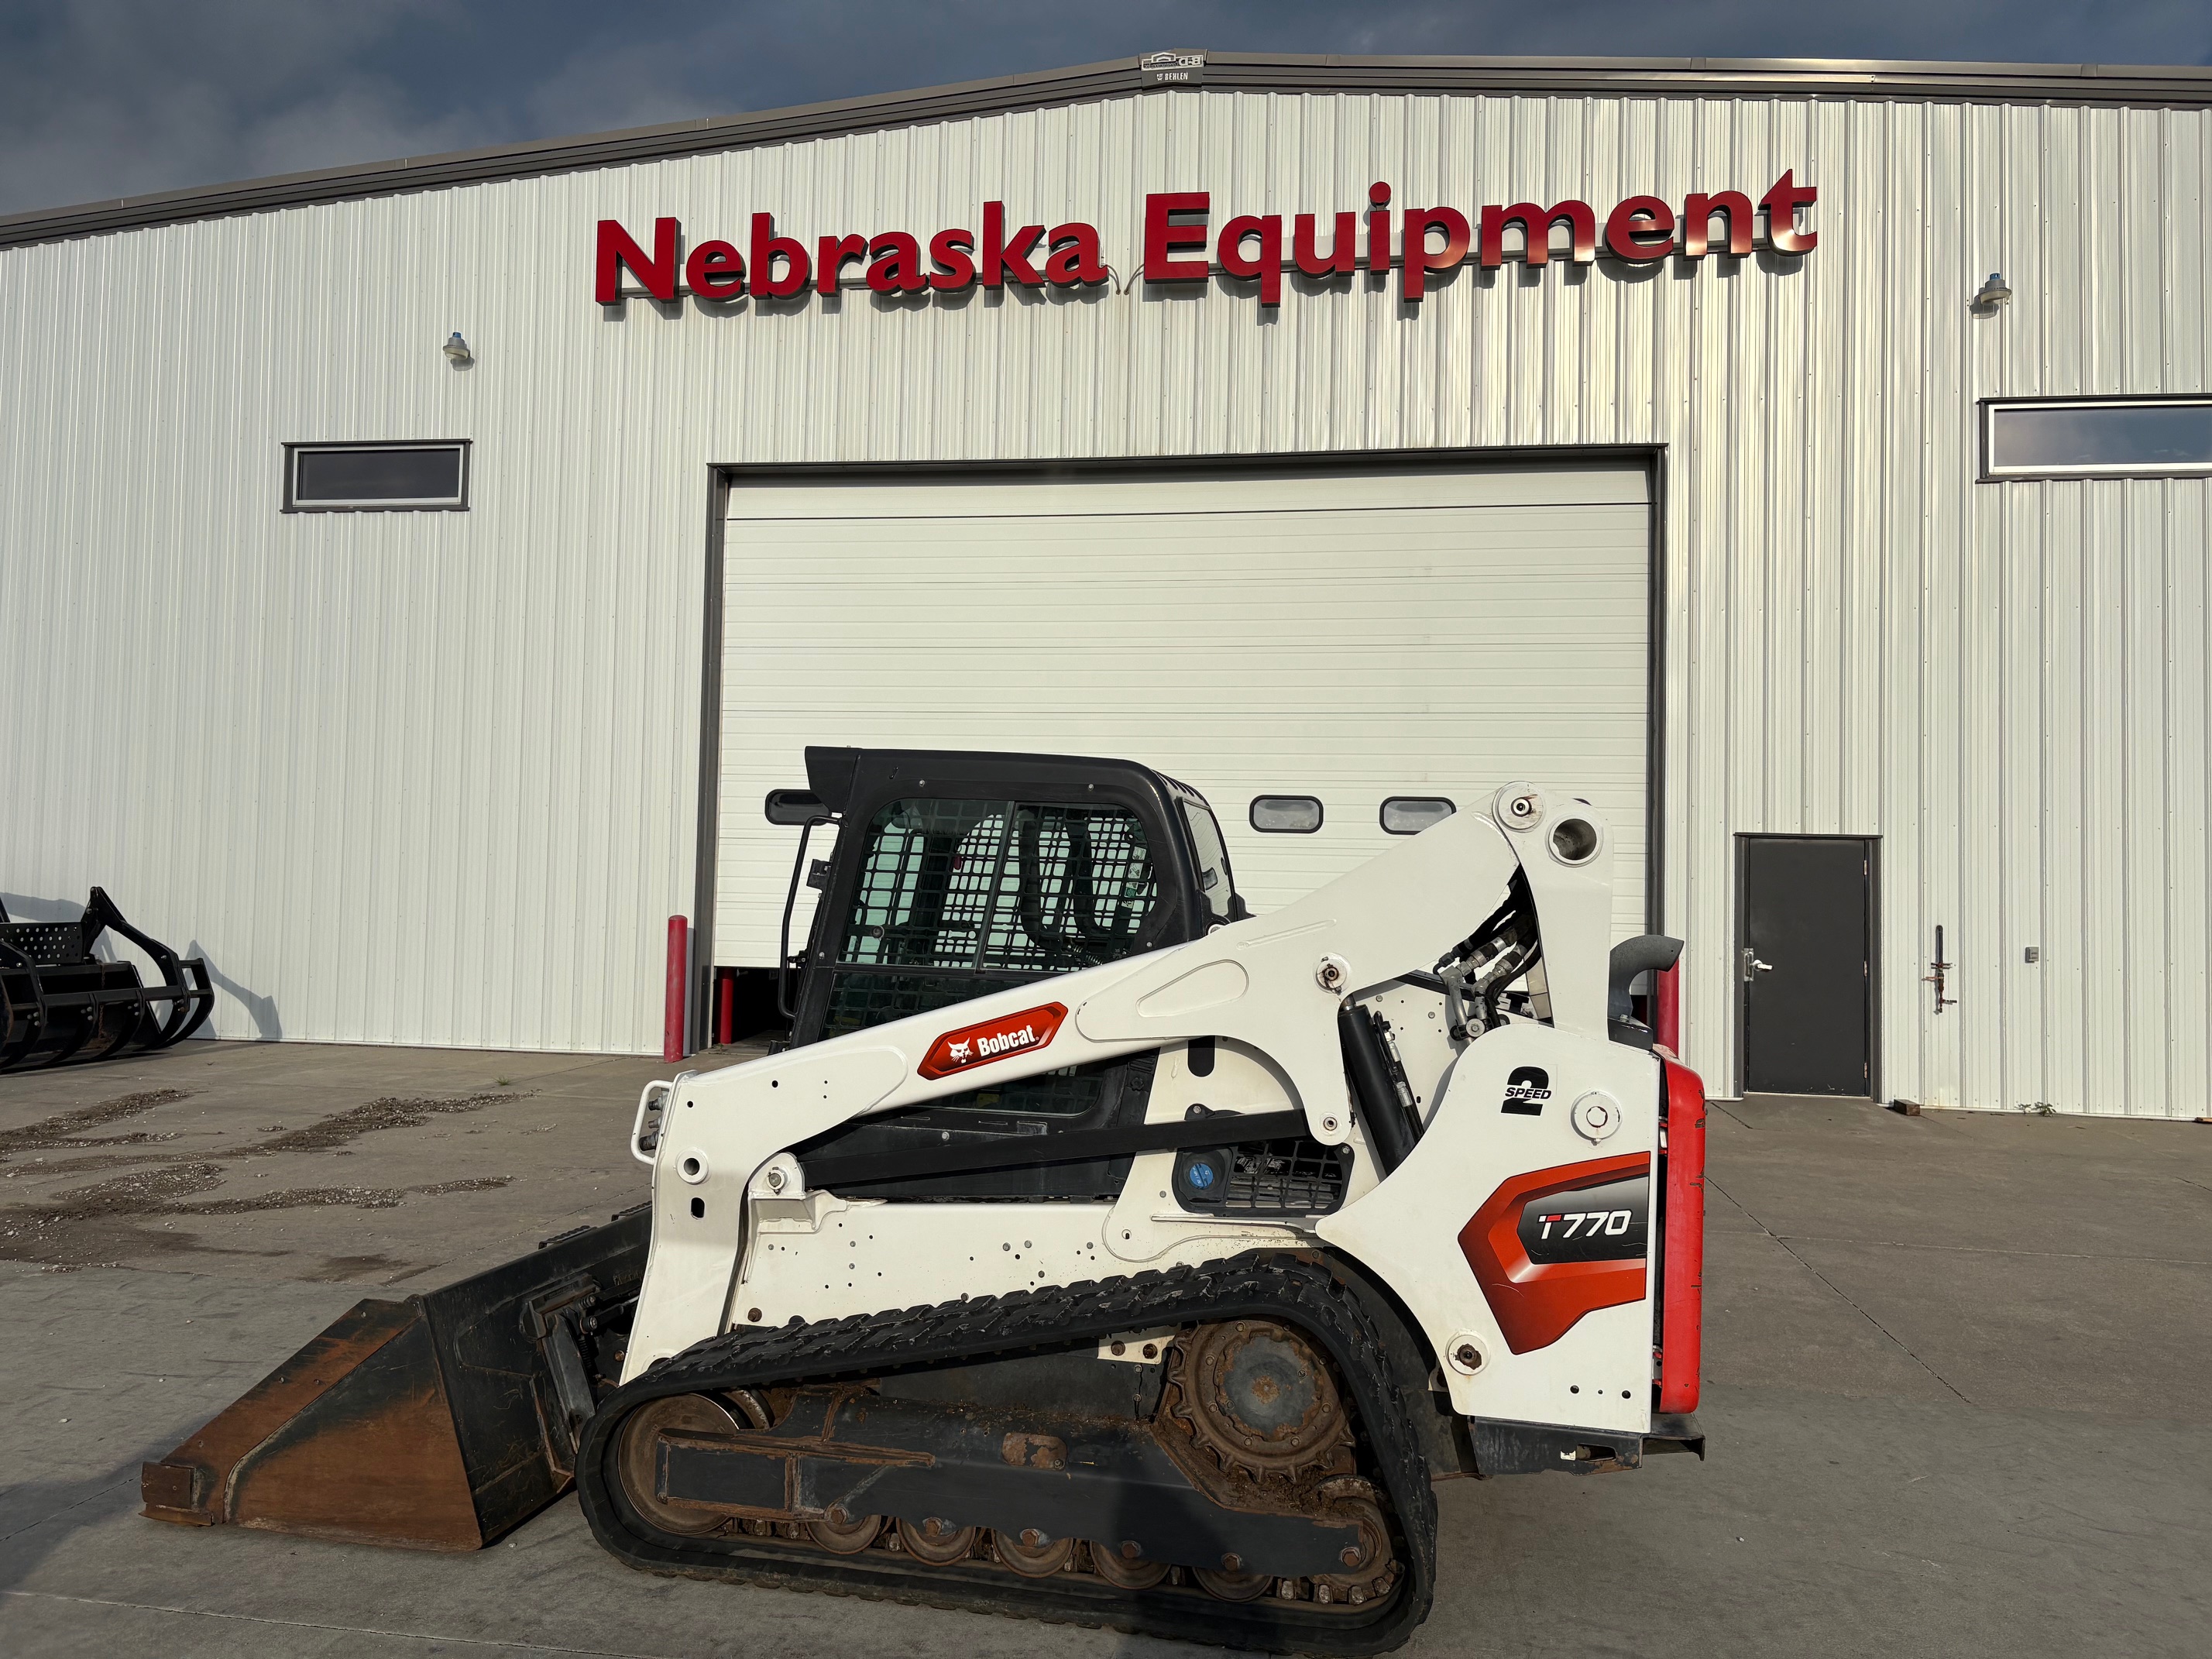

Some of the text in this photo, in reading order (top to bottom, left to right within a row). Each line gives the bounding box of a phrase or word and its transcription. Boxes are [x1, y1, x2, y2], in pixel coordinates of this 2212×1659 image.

[1165, 72, 1188, 81] BEHLEN
[595, 168, 1818, 308] Nebraska Equipment
[1500, 1066, 1549, 1116] 2
[1504, 1087, 1552, 1100] SPEED
[1538, 1210, 1633, 1240] T770
